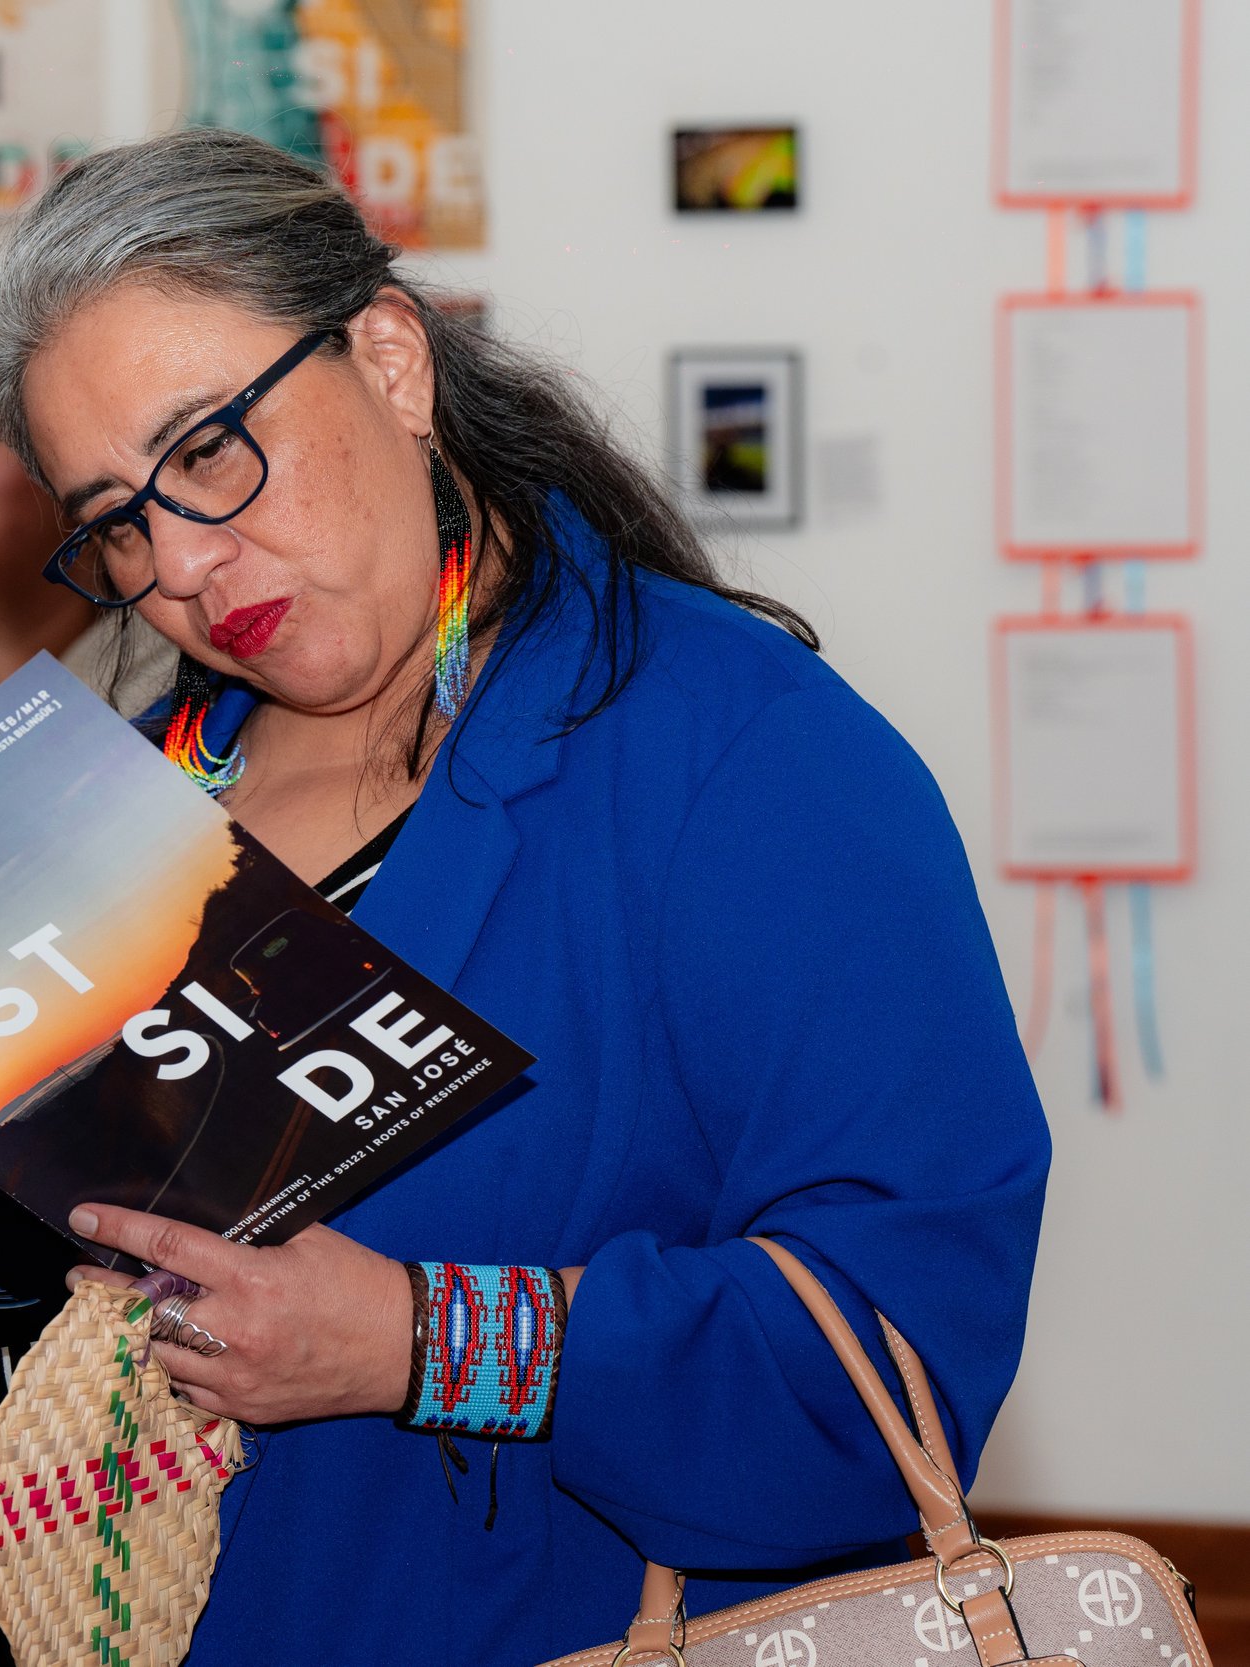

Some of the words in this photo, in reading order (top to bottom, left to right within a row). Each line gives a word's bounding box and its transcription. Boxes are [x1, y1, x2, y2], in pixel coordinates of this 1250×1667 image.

[122, 981, 255, 1081] SI
[277, 992, 454, 1124] DE
[354, 1091, 407, 1130] SAN
[412, 1038, 476, 1091] JOSÉ
[252, 1201, 298, 1235] RHYTHM
[297, 1189, 312, 1203] OF
[311, 1173, 336, 1191] THE
[334, 1150, 366, 1175] 95122
[373, 1118, 411, 1148] ROOTS
[410, 1106, 426, 1120] OF
[427, 1057, 493, 1109] RESISTANCE
[260, 1178, 305, 1214] MARKETING
